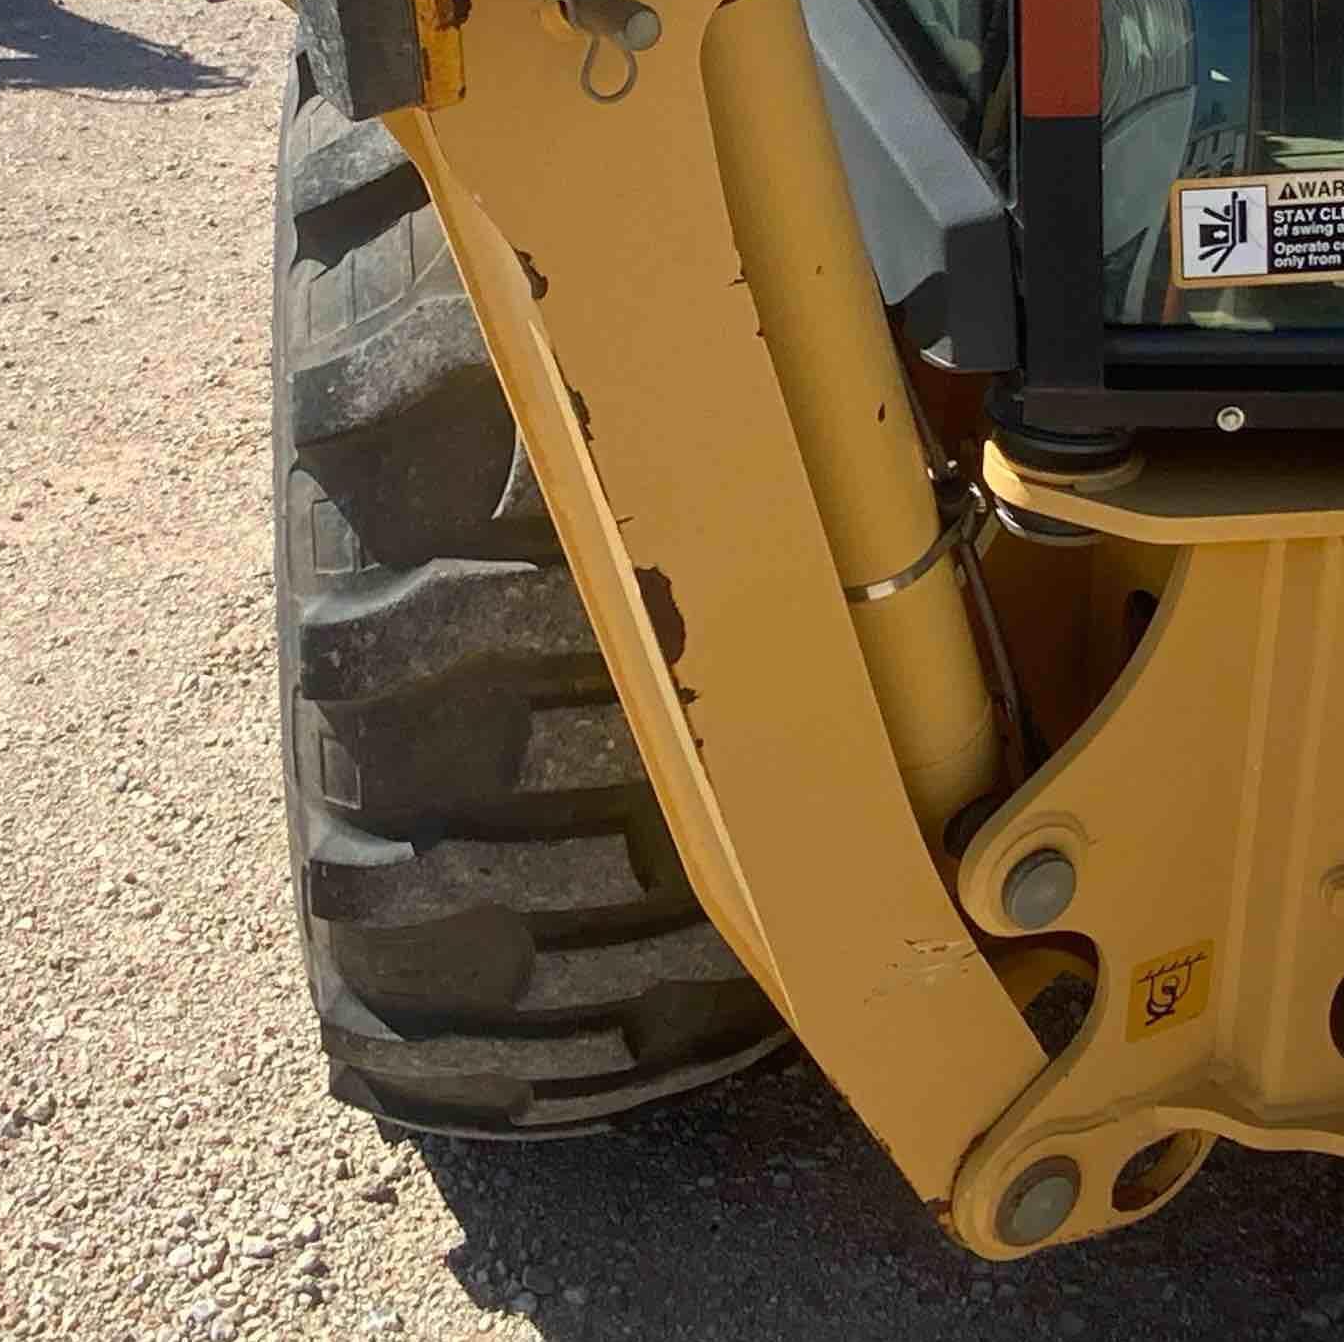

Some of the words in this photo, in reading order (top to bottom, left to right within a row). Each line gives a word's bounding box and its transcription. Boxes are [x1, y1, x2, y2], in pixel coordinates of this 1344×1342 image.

[1274, 208, 1316, 223] STAY
[1273, 223, 1289, 238] of
[1291, 222, 1334, 238] swing
[1274, 241, 1330, 258] Operate
[1274, 256, 1305, 269] only
[1308, 252, 1342, 267] from
